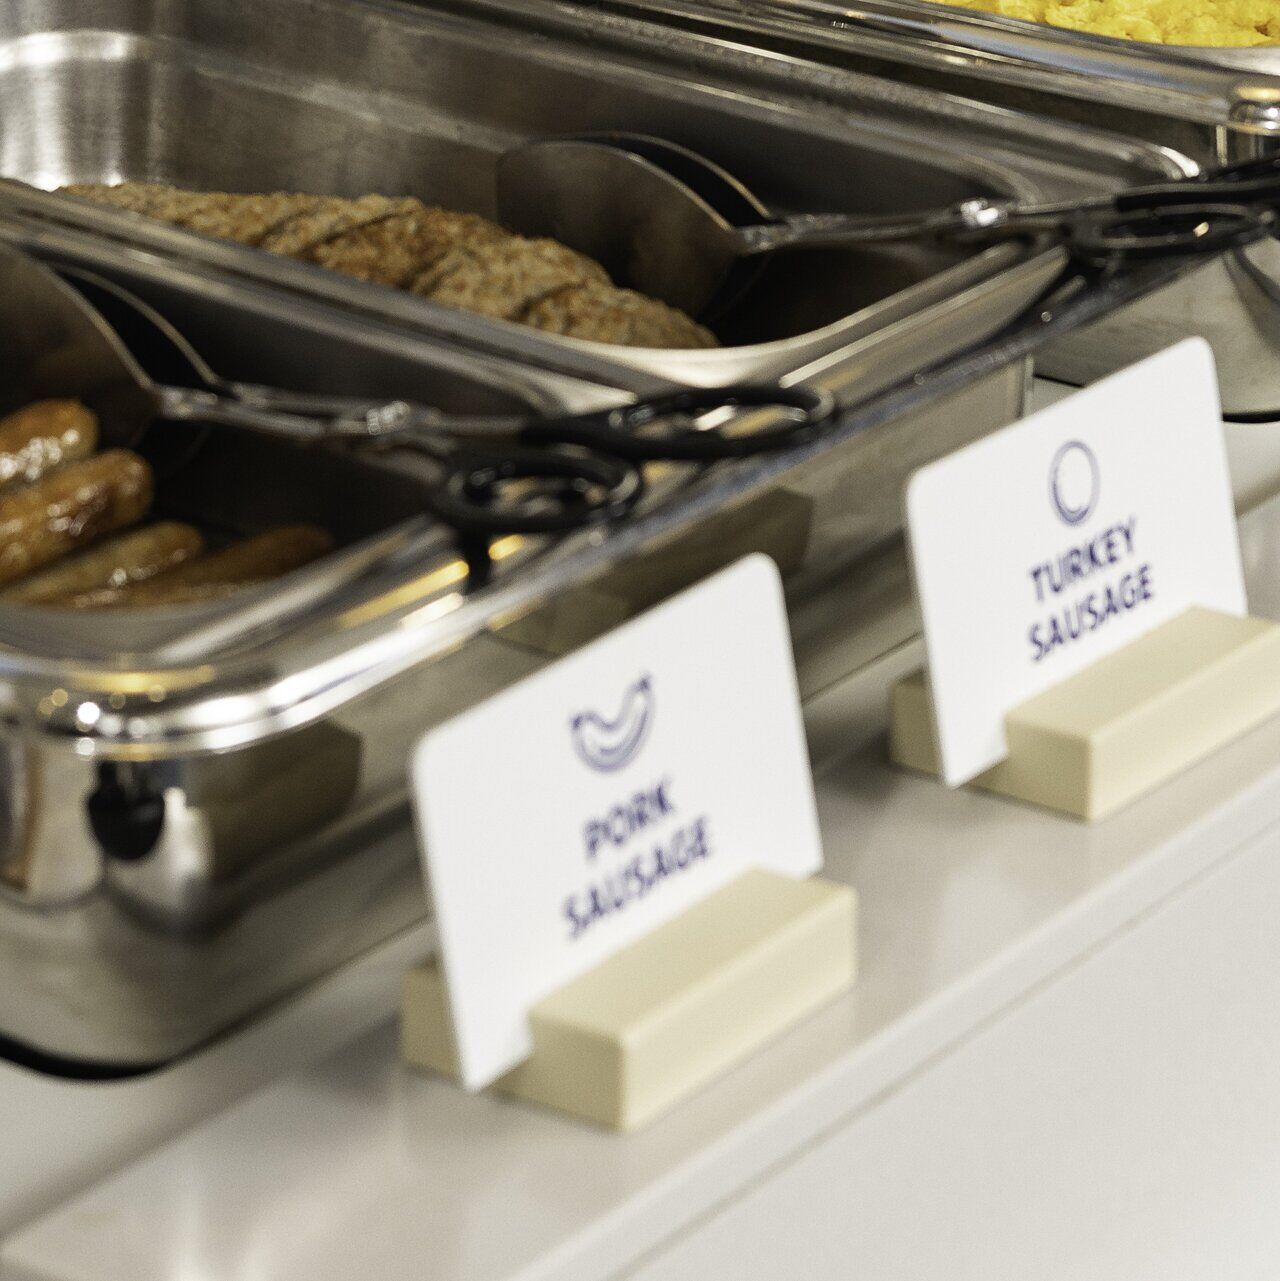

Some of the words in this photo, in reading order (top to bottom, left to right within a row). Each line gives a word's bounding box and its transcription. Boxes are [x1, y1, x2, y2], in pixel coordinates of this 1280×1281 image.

[1029, 514, 1138, 604] TURKEY
[1027, 564, 1154, 663] SAUSAGE
[583, 775, 676, 860] PORK
[563, 815, 711, 941] SAUSAGE
